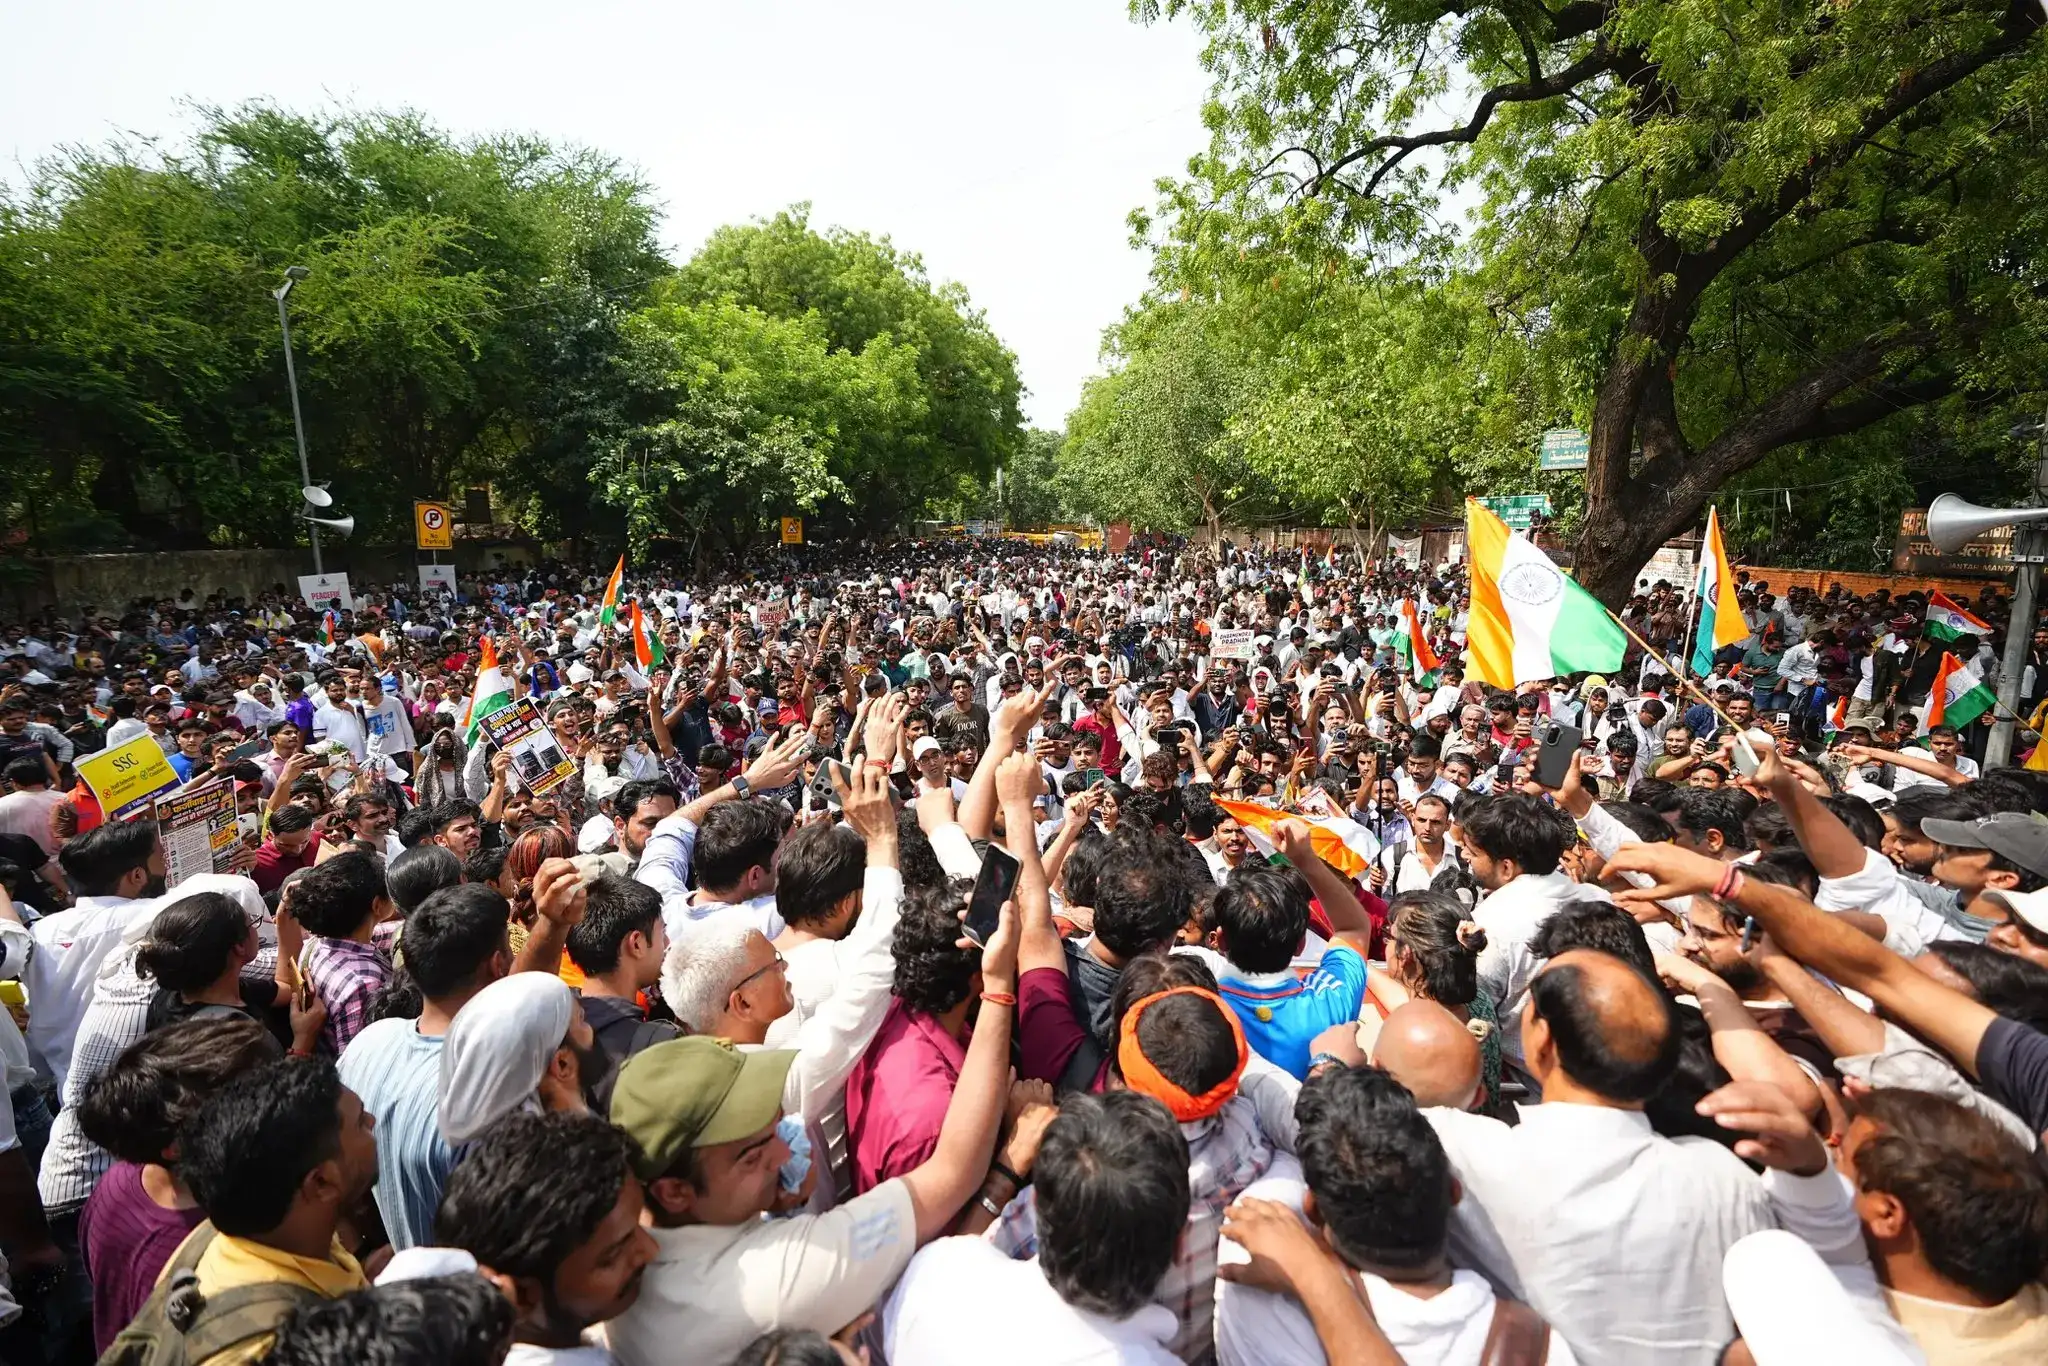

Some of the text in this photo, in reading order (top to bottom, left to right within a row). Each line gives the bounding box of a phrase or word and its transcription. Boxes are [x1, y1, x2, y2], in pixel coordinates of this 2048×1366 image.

[1983, 564, 2018, 572] MANTA
[488, 703, 518, 722] DELHI POLICE
[490, 712, 518, 730] CONSTABLE
[516, 704, 530, 716] EXAM
[957, 720, 977, 731] DIOR
[112, 753, 139, 772] SSC
